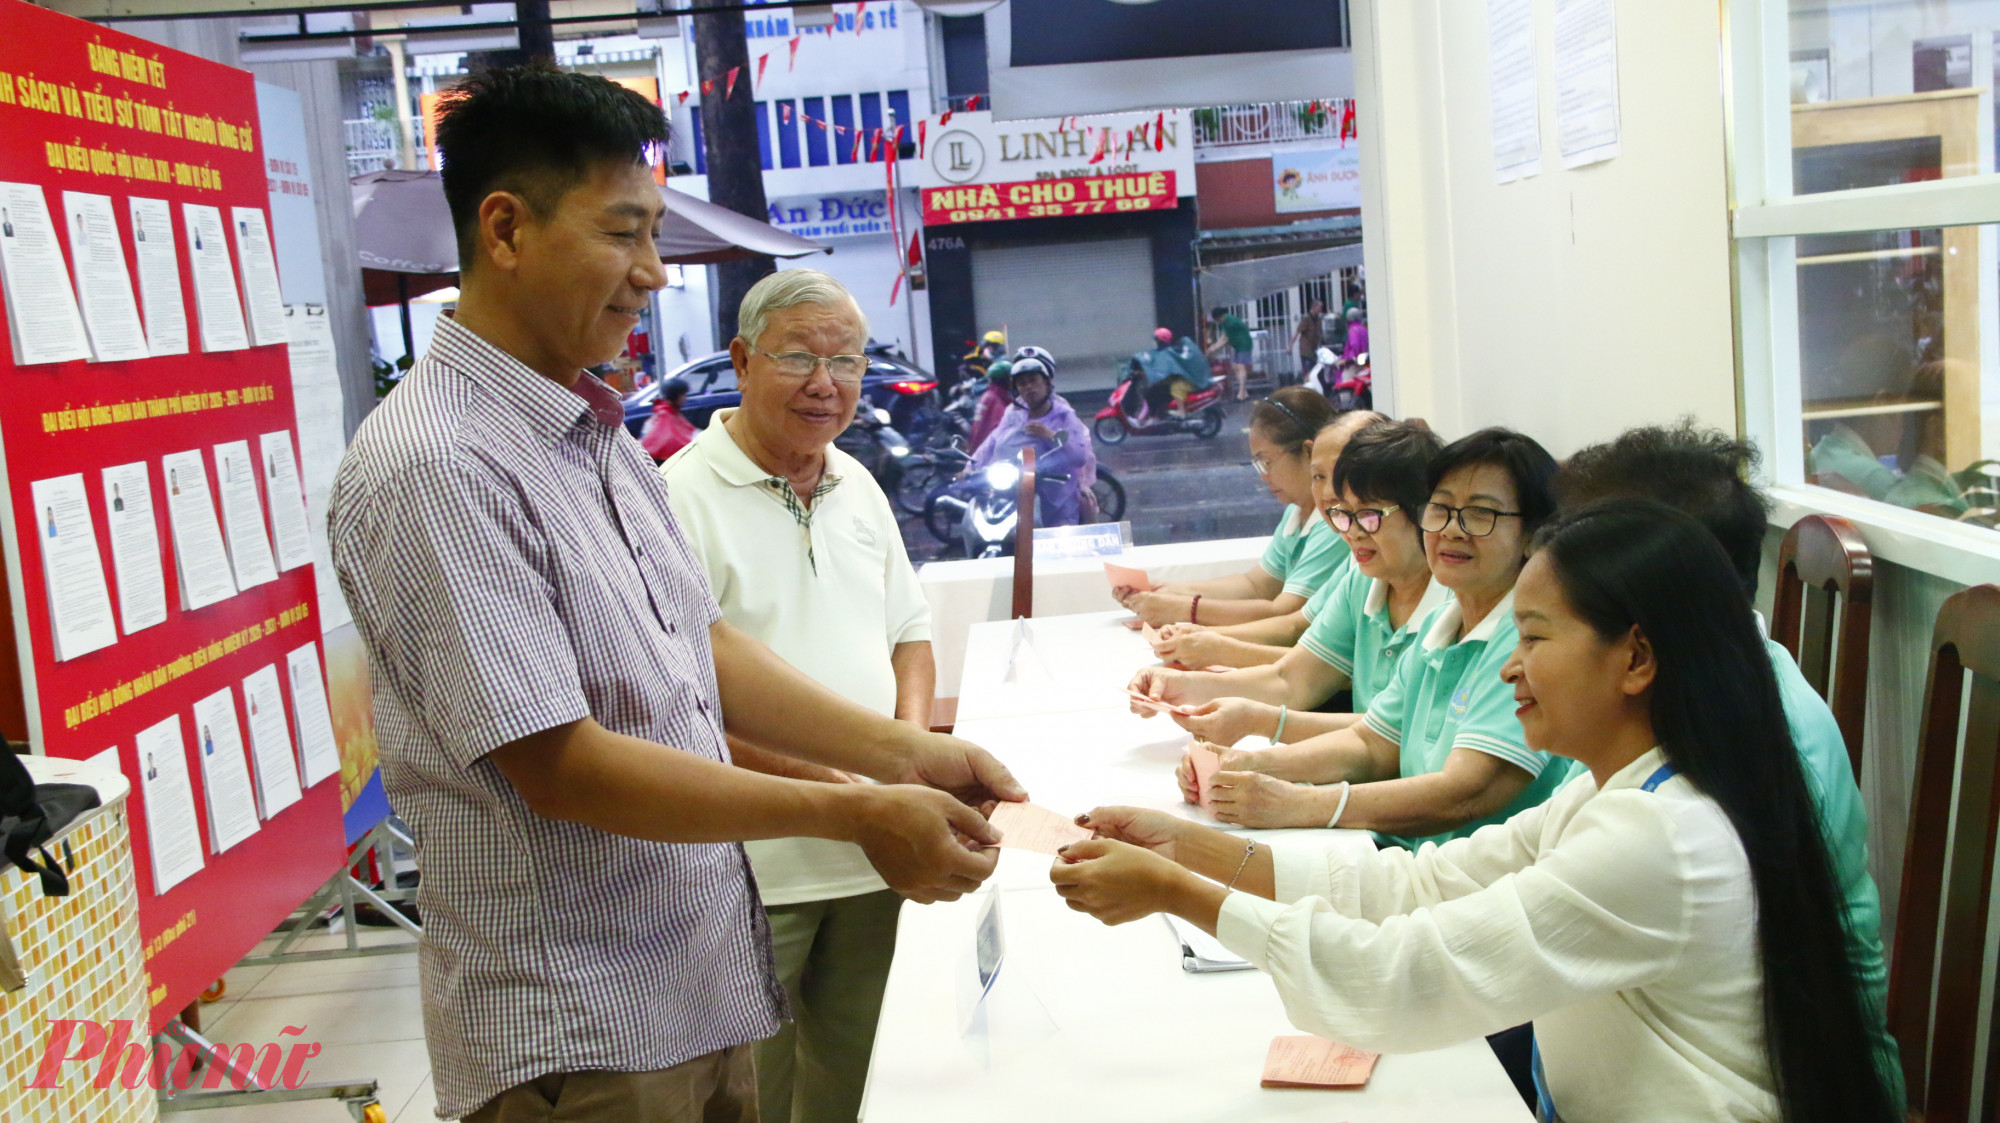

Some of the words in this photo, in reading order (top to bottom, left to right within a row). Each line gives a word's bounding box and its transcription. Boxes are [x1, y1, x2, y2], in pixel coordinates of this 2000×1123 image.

[836, 11, 874, 32] QUC
[87, 35, 120, 78] BẢNG
[147, 53, 166, 89] YẾT
[17, 72, 61, 114] SÁCH
[60, 81, 83, 118] VÀ
[82, 82, 114, 124] TIỂU
[115, 90, 134, 128] SỬ
[134, 99, 162, 134] TÓM
[161, 101, 183, 138] TẮT
[45, 141, 66, 174] ĐẠI
[64, 136, 90, 172] BIỂU
[89, 142, 116, 176] QUỐC
[115, 149, 134, 183] HỘI
[999, 129, 1087, 162] LINH
[1101, 121, 1177, 154] LAN
[931, 184, 1000, 211] NHÀ
[1010, 182, 1075, 206] CHO
[1084, 172, 1167, 199] THUÊ
[768, 202, 809, 225] An
[819, 197, 886, 221] Đức
[949, 206, 1016, 222] 0941
[1028, 203, 1063, 217] 35
[1071, 200, 1107, 214] 77
[358, 250, 441, 270] Coffee
[928, 236, 965, 251] 476A
[42, 411, 58, 436] ĐẠI
[57, 402, 78, 431] BIỂU
[76, 404, 92, 432] HỘI
[90, 400, 113, 426] ĐỒNG
[65, 705, 81, 731] ĐẠI
[79, 690, 99, 722] BIỂU
[98, 688, 114, 715] HỘI
[112, 679, 134, 707] ĐỒNG
